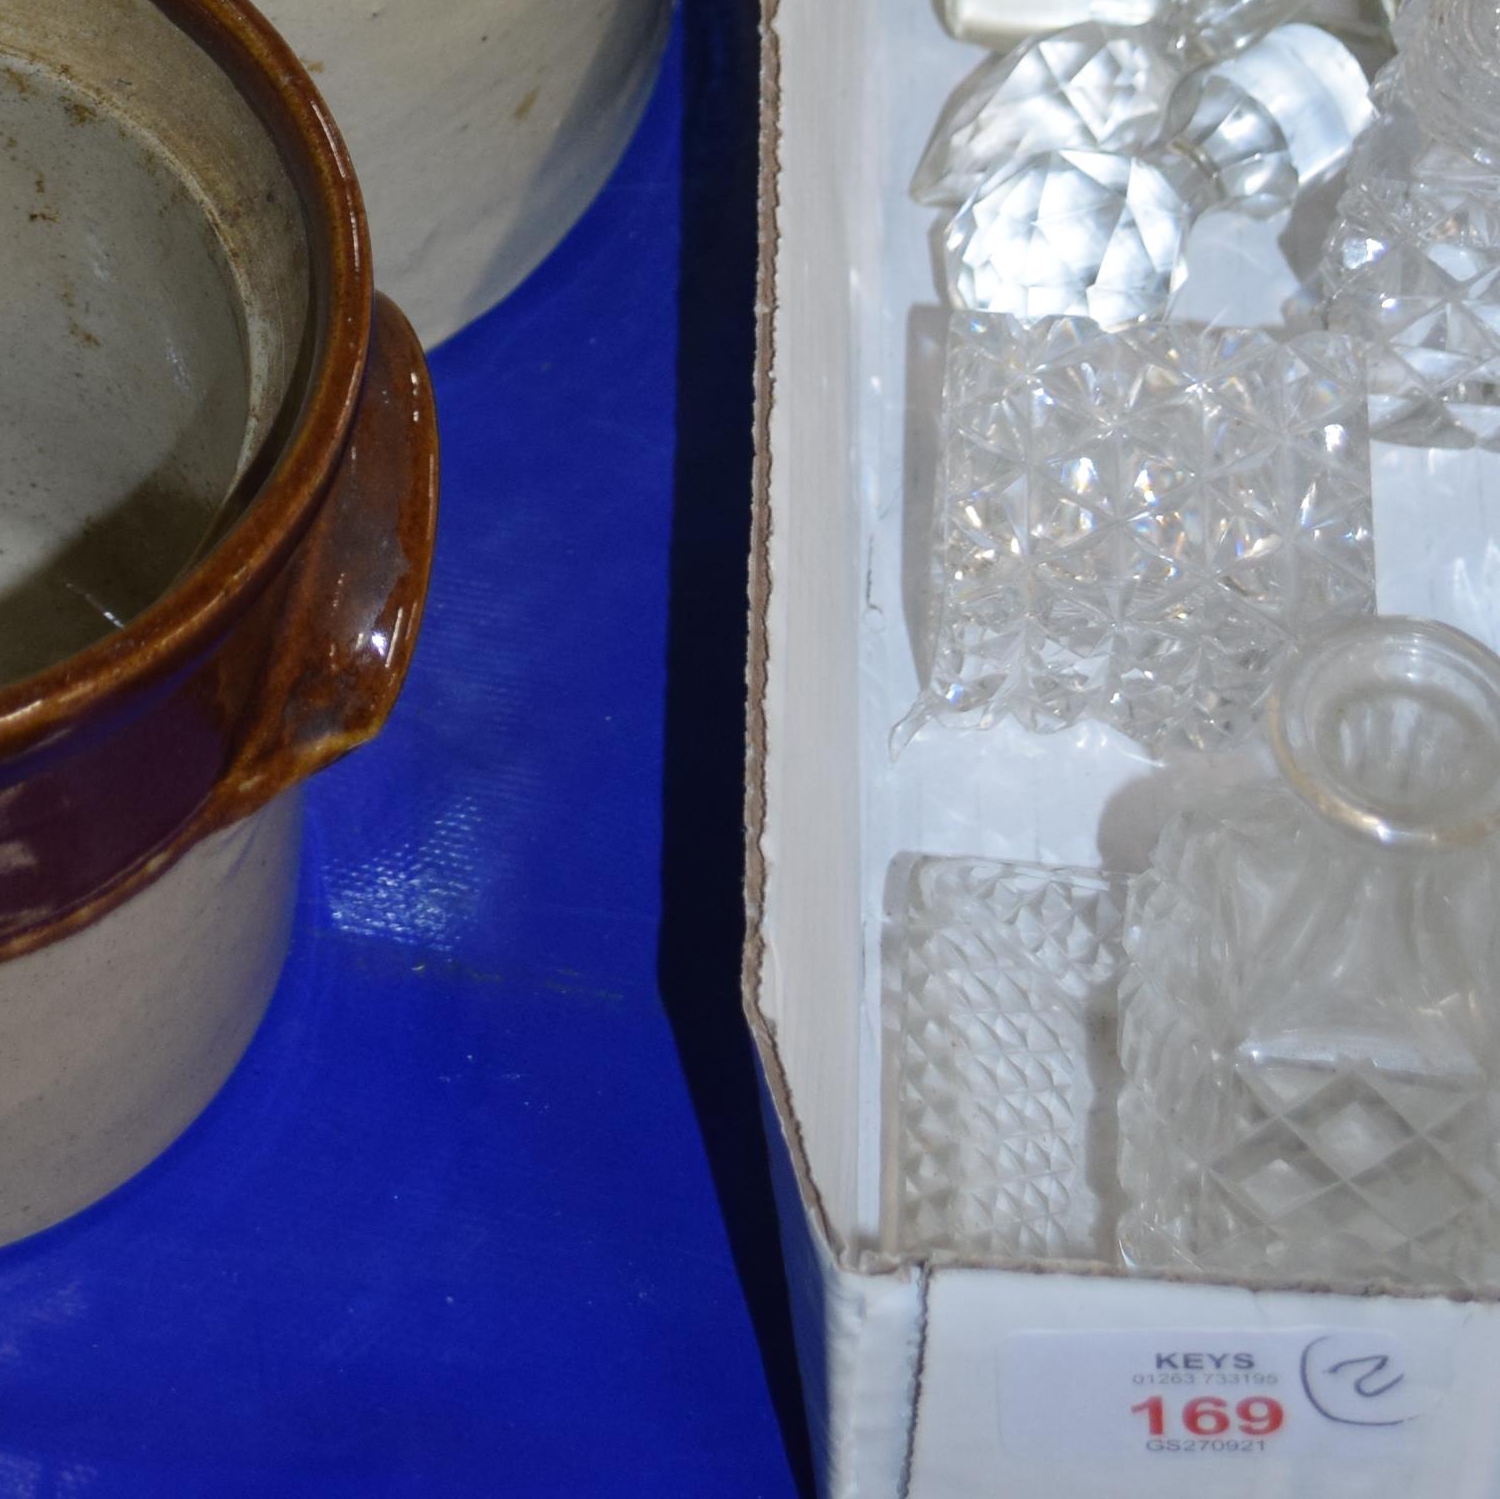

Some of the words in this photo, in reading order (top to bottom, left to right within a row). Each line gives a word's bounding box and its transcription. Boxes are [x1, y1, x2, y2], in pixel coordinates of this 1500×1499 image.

[1155, 1352, 1256, 1371] KEYS
[1131, 1373, 1196, 1387] 01263
[1203, 1373, 1279, 1387] 733195
[1130, 1395, 1285, 1437] 169
[1145, 1438, 1267, 1454] GS270921
